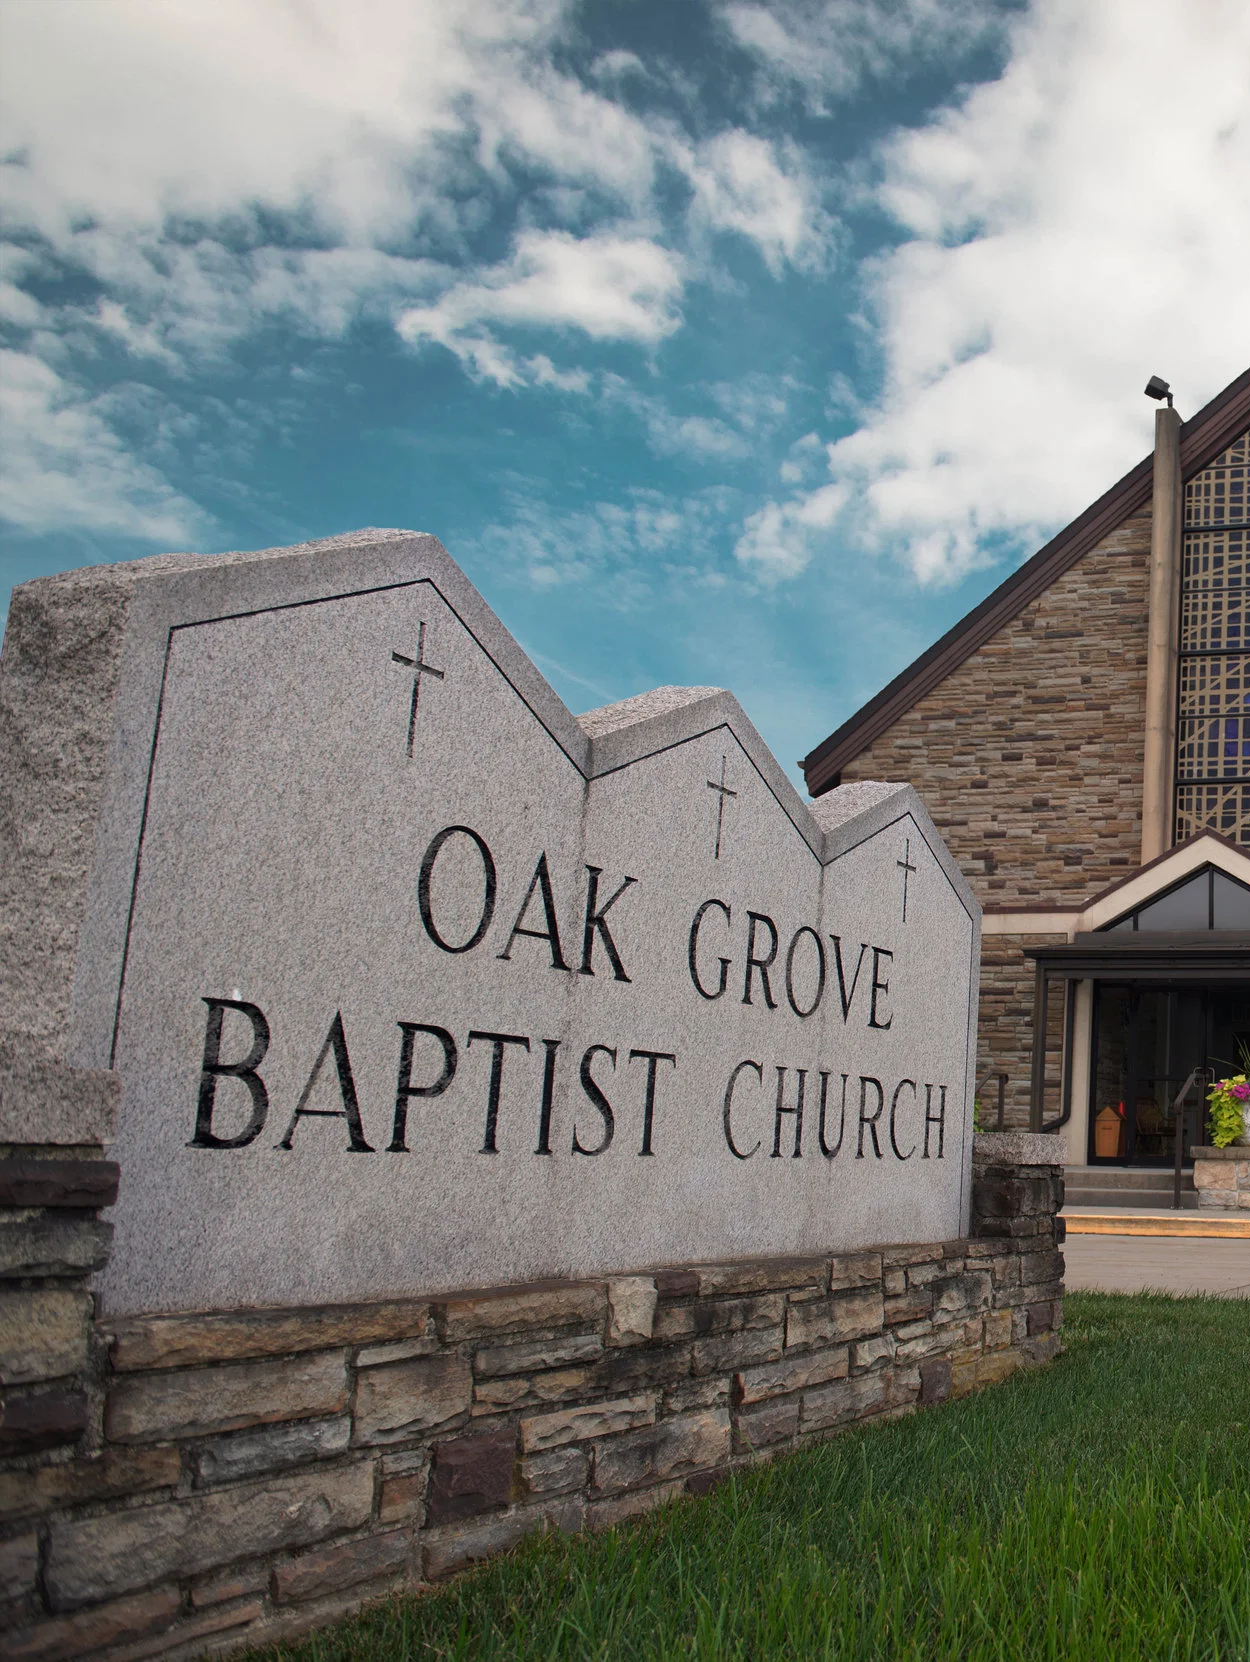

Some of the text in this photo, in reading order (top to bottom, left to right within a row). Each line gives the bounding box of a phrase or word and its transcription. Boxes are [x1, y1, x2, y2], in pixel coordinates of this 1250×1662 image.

[418, 825, 894, 1030] OAK GROVE
[186, 997, 947, 1160] BAPTIST CHURCH
